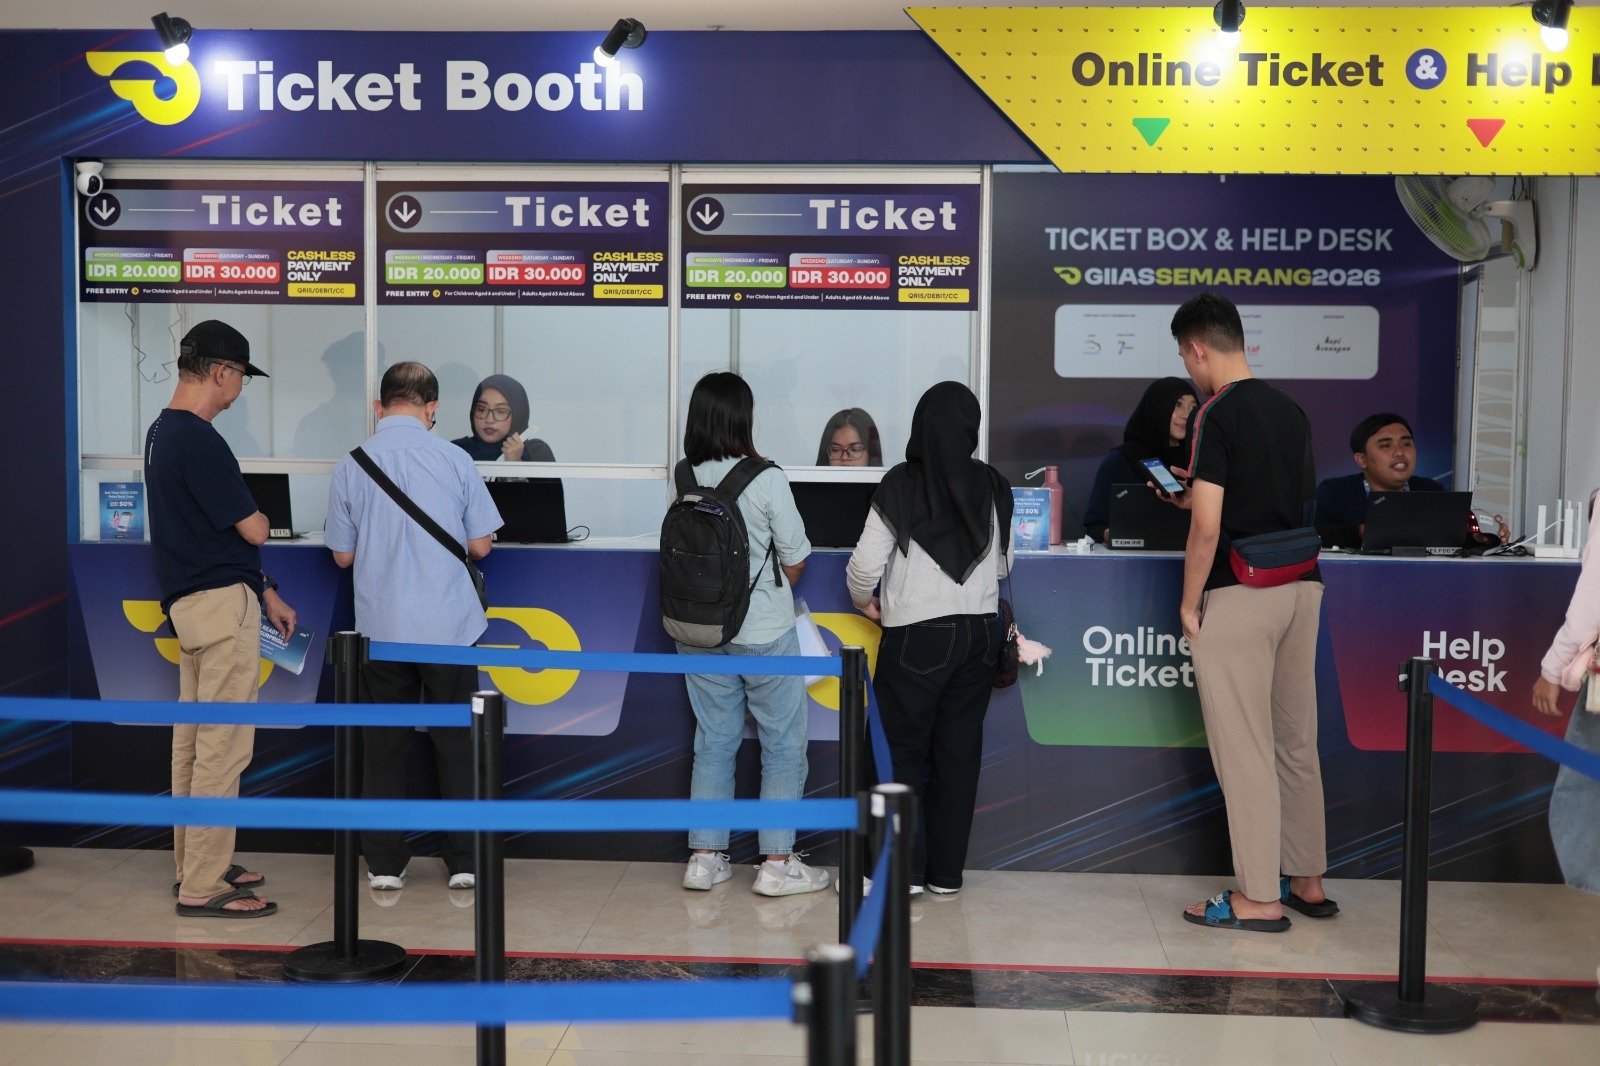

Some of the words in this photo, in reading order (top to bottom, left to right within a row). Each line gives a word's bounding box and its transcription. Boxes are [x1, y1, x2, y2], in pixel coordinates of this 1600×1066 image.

[1072, 51, 1221, 87] Online
[1240, 52, 1384, 87] Ticket
[1415, 55, 1440, 80] &
[1467, 52, 1572, 94] Help
[214, 60, 421, 112] Ticket
[446, 60, 644, 112] Booth
[202, 195, 342, 226] Ticket
[505, 196, 650, 227] Ticket
[809, 199, 956, 230] Ticket
[1045, 227, 1142, 251] TICKET
[1147, 228, 1208, 251] BOX
[1215, 228, 1233, 251] &
[1242, 228, 1312, 251] HELP
[1319, 229, 1393, 252] DESK
[288, 250, 355, 261] CASHLESS
[593, 252, 663, 262] CASHLESS
[898, 255, 970, 266] CASHLESS
[89, 264, 117, 277] IDR
[122, 265, 178, 277] 20.000
[186, 265, 215, 278] IDR
[220, 266, 276, 278] 30.000
[288, 261, 351, 271] PAYMENT
[593, 262, 659, 272] PAYMENT
[898, 266, 965, 276] PAYMENT
[288, 271, 321, 282] ONLY
[389, 267, 418, 280] IDR
[423, 267, 481, 280] 20.000
[489, 267, 519, 280] IDR
[524, 267, 582, 280] 30.000
[593, 272, 628, 283] ONLY
[689, 270, 719, 282] IDR
[725, 270, 783, 283] 20.000
[792, 270, 822, 283] IDR
[828, 271, 887, 284] 30.000
[898, 276, 934, 287] ONLY
[262, 625, 279, 635] READY
[1083, 626, 1192, 656] Online
[1423, 631, 1505, 667] Help
[1086, 658, 1194, 688] Ticket
[1438, 663, 1508, 692] esk
